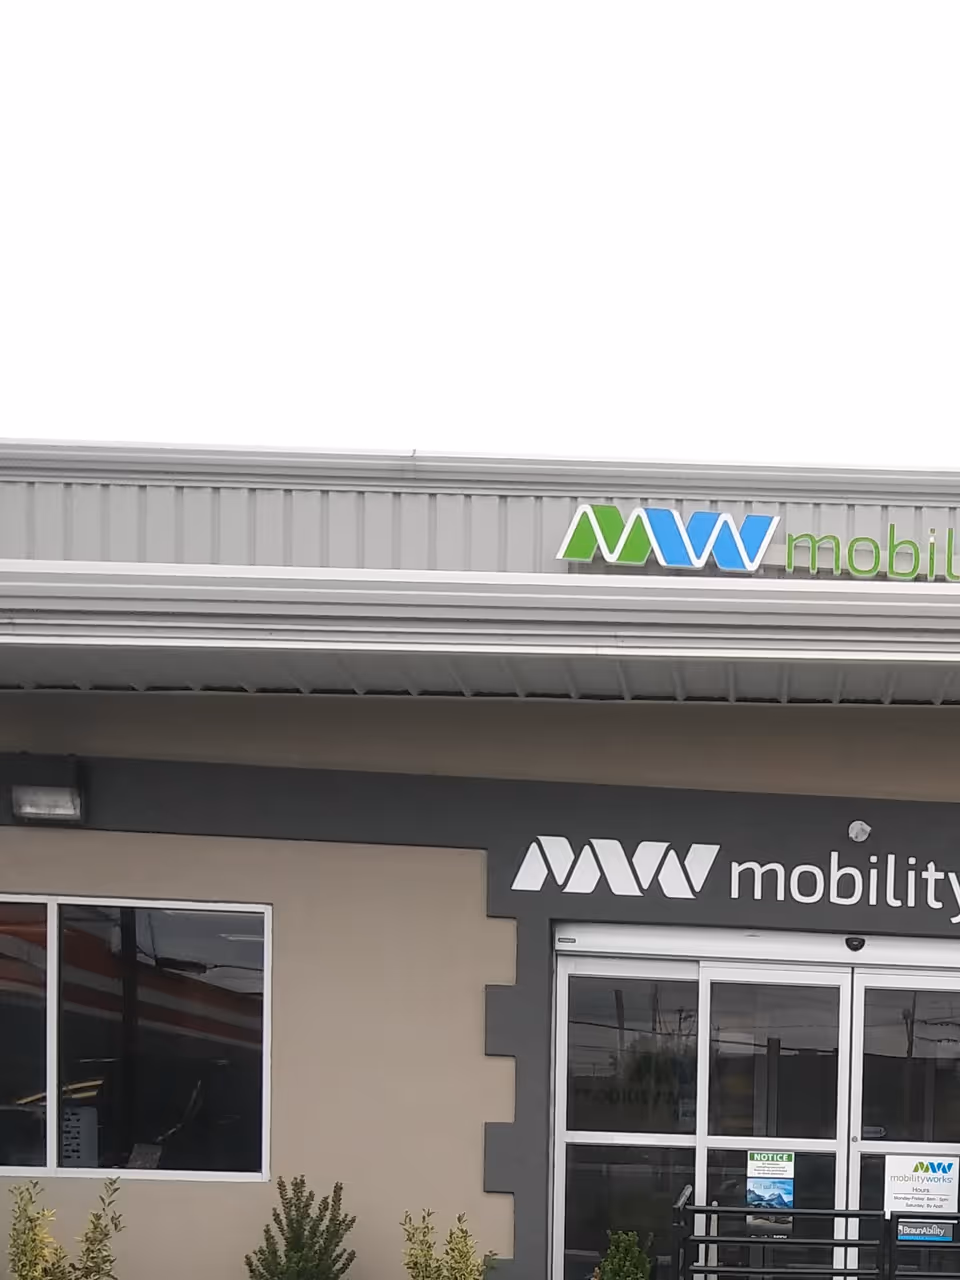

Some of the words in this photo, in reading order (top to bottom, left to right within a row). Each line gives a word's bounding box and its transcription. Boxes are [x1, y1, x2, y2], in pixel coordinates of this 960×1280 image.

[753, 1153, 789, 1162] NOTICE
[890, 1174, 954, 1184] mobilityworks
[903, 1224, 945, 1237] BraunAbility
